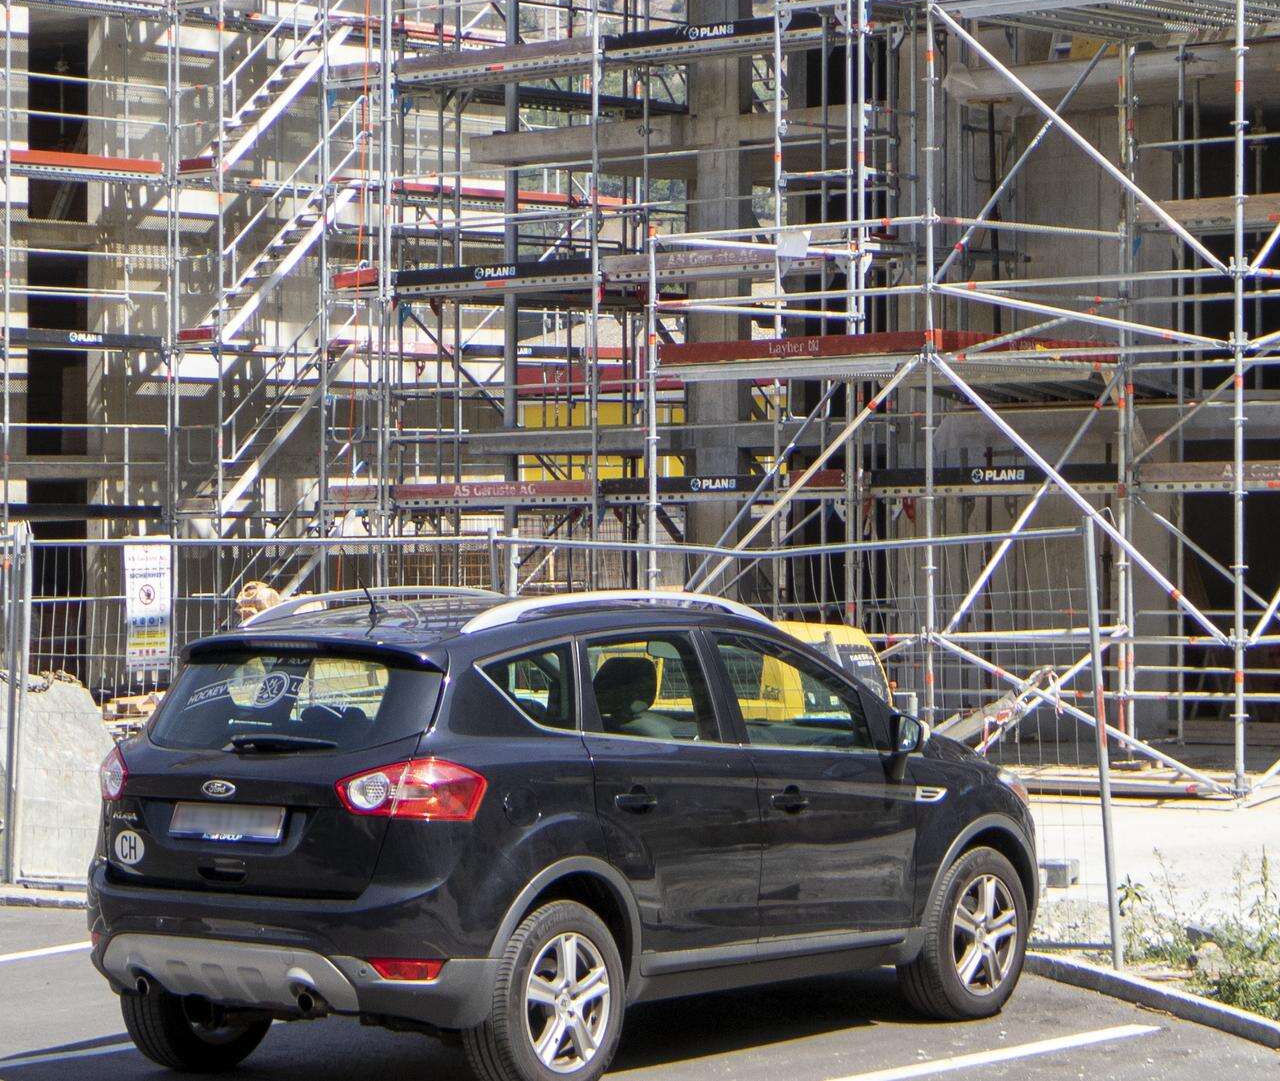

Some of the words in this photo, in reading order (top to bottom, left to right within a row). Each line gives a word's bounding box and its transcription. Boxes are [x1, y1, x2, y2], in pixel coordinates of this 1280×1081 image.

[768, 340, 805, 355] Layher
[453, 485, 470, 497] AS
[518, 483, 536, 496] AG
[121, 835, 136, 860] CH
